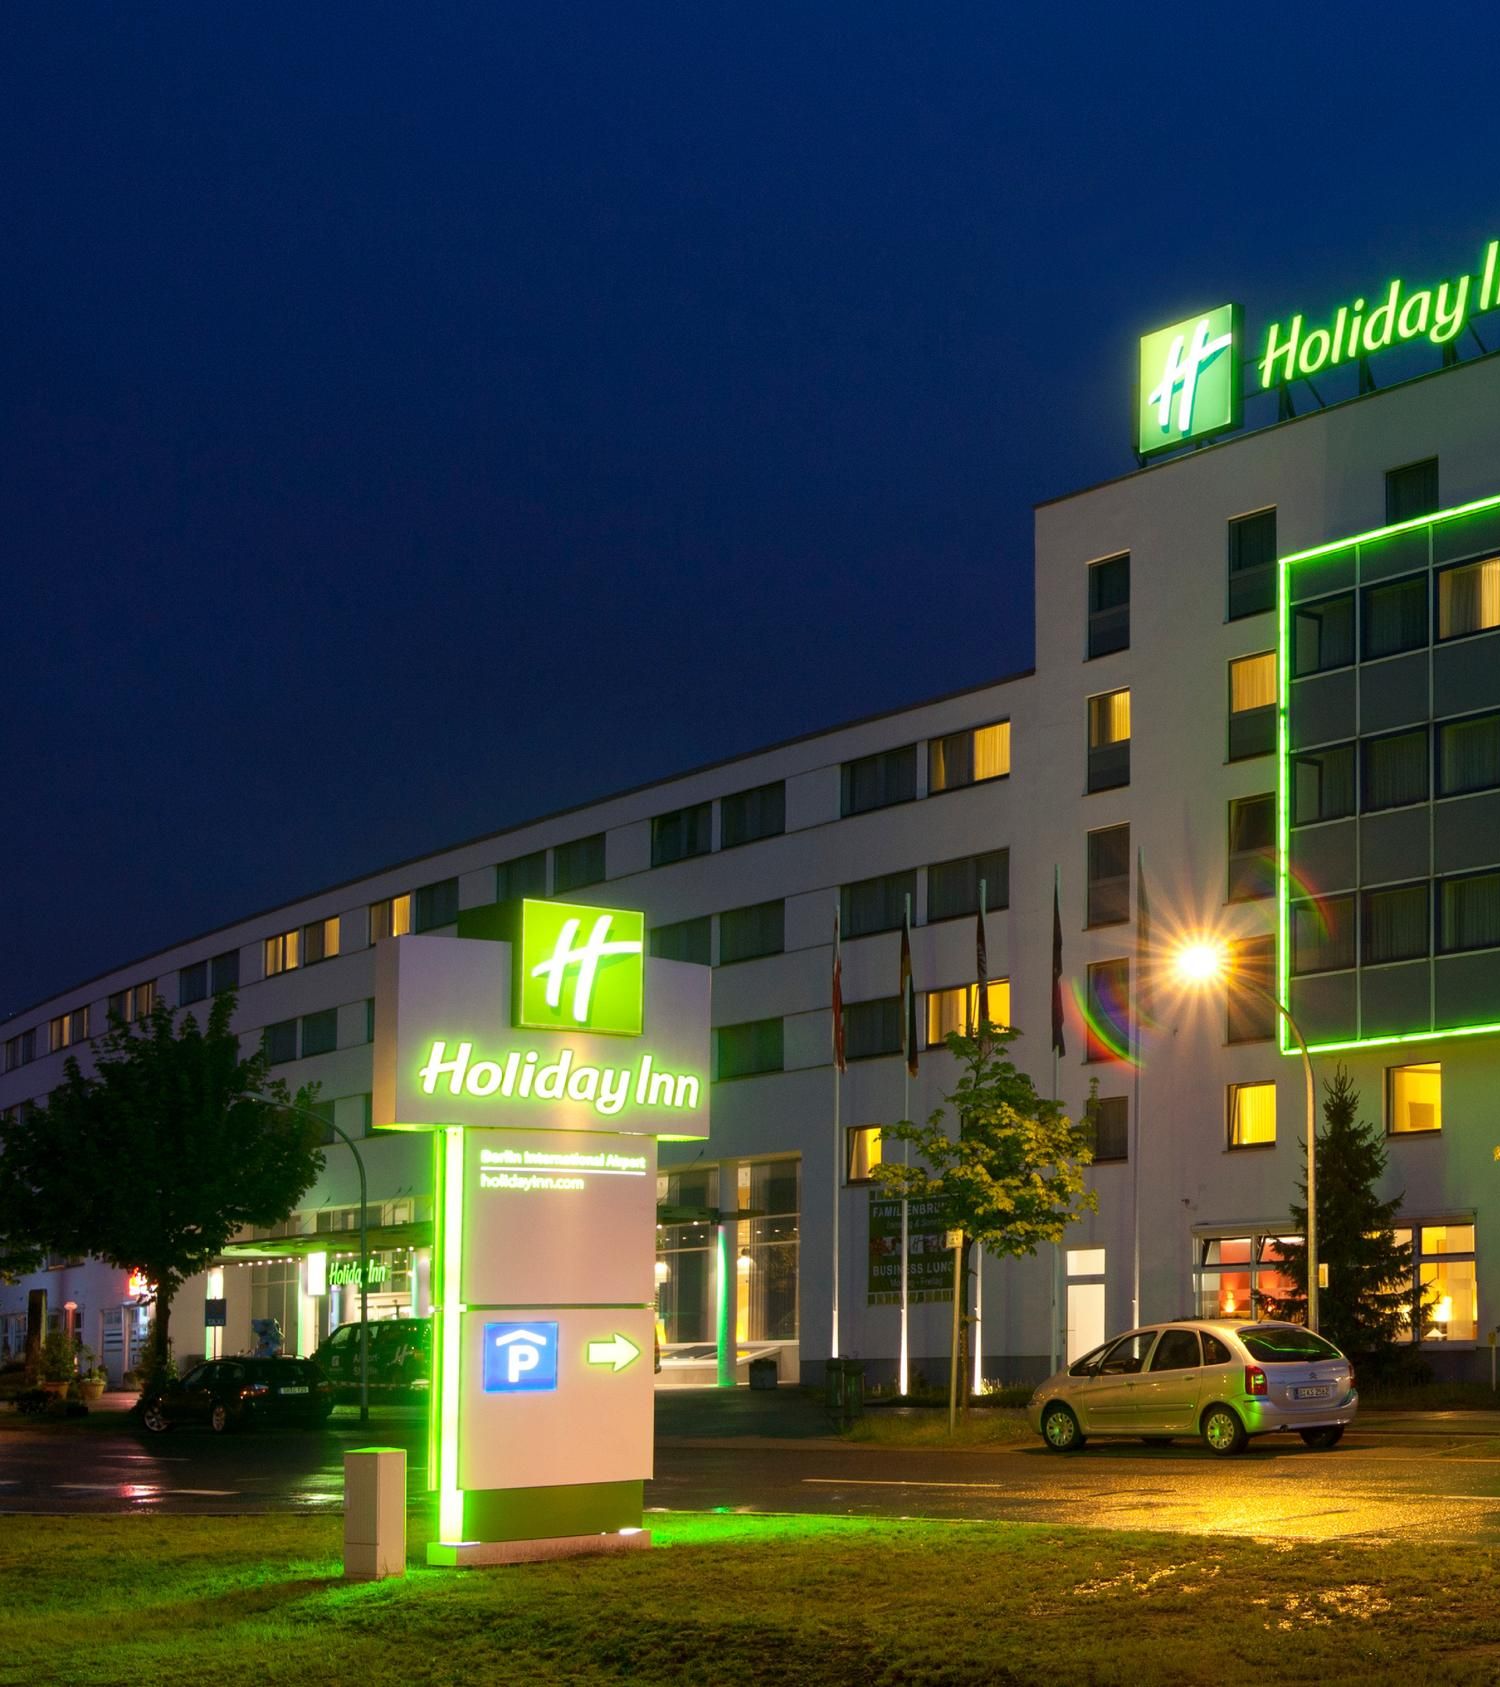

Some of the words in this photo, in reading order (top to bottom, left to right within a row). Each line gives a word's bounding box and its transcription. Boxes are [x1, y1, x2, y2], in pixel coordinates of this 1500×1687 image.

[1257, 273, 1472, 389] Holiday
[417, 1040, 631, 1115] Holiday
[637, 1054, 700, 1109] Inn
[480, 1149, 522, 1164] Berlin
[524, 1150, 605, 1167] International
[606, 1154, 647, 1170] Airport
[480, 1173, 584, 1191] holidayinn.com
[368, 1259, 386, 1284] Inn
[927, 1260, 954, 1274] LUNC
[507, 1344, 540, 1383] P
